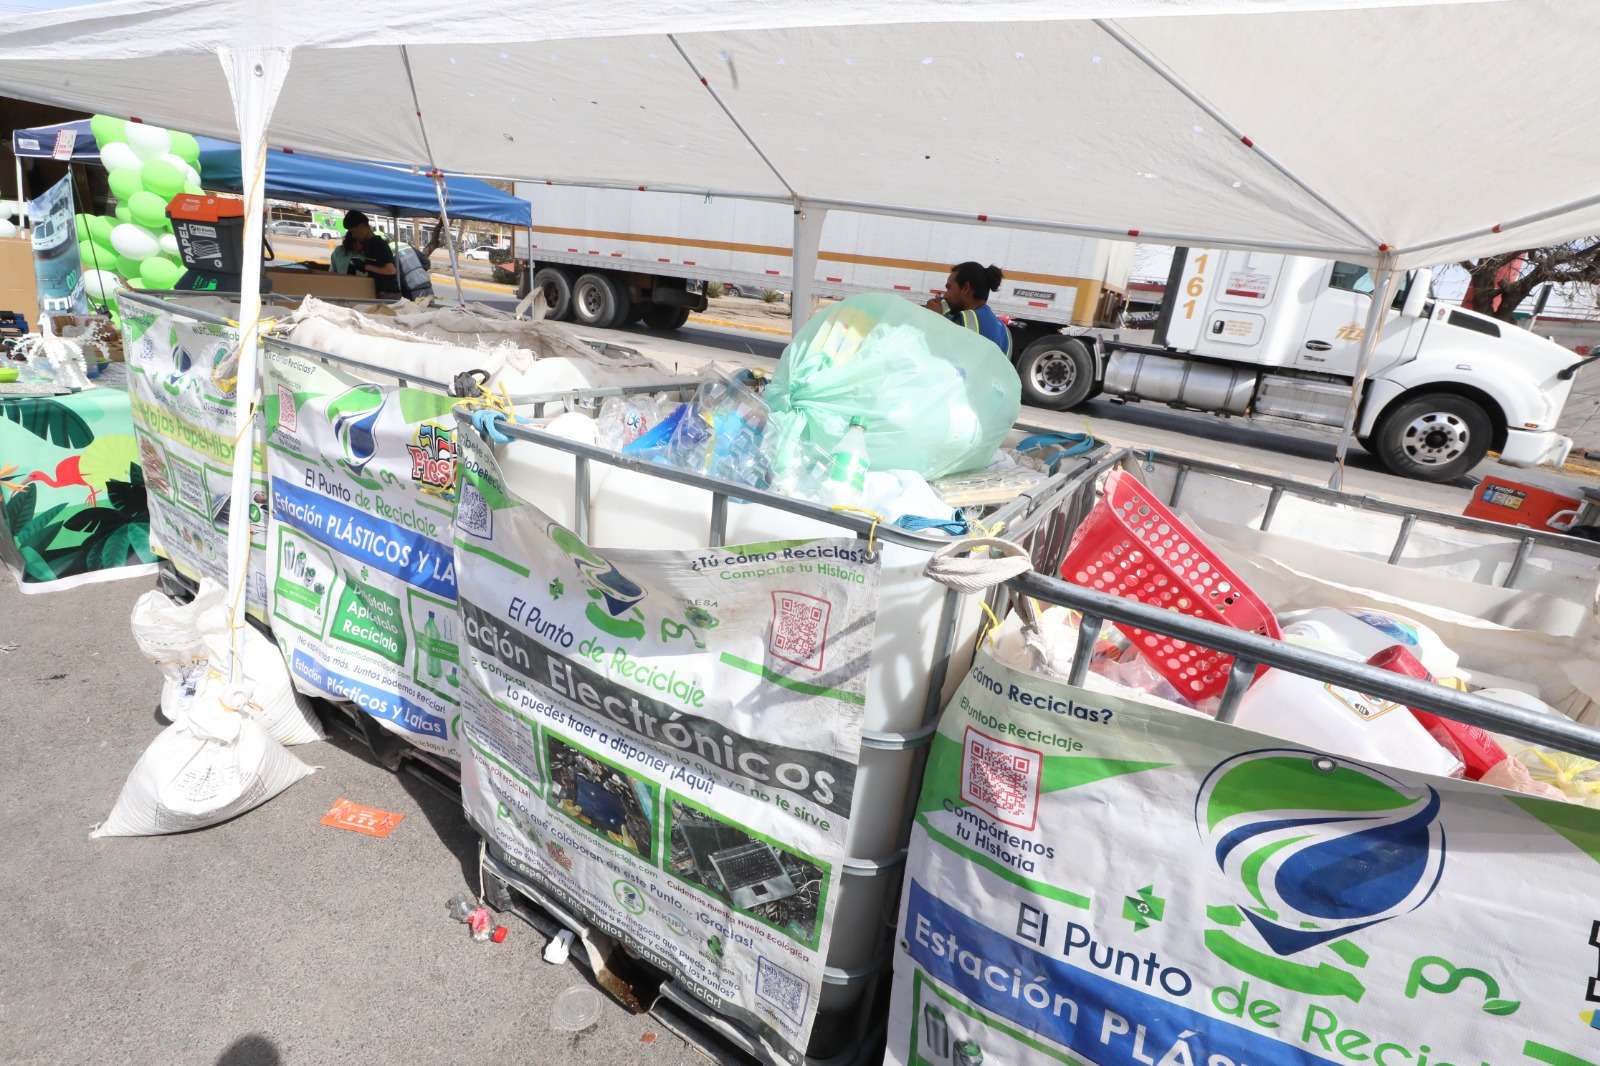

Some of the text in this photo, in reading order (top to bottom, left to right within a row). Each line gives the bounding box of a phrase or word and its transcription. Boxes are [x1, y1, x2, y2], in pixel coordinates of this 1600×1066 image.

[178, 222, 197, 264] PAPEL
[275, 492, 323, 529] Estación
[326, 515, 412, 568] PLÁSTICOS
[418, 551, 430, 574] Y
[305, 468, 438, 538] El Punto de Reciclaje
[691, 545, 865, 572] ¿Tú cómo Reciclas?
[719, 561, 866, 585] Comparte tu Historia
[352, 664, 381, 682] Juntos
[381, 676, 416, 699] podemos
[508, 596, 706, 709] El Punto de Reciclaje
[295, 658, 442, 734] Estación Plásticos y Latas
[959, 695, 1084, 753] ElPuntoDeReciclaje
[1008, 684, 1114, 726] Reciclas?
[506, 685, 715, 796] Lo puedes traer a disponer ¡Aquí!
[546, 653, 836, 806] Electrónicos
[774, 794, 790, 812] te
[794, 806, 831, 832] sirve
[942, 798, 1055, 860] Compártenos
[956, 821, 1036, 874] tu Historia
[551, 826, 604, 865] colaboran
[695, 910, 754, 950] ¡Gracias!
[591, 914, 622, 939] Juntos
[625, 934, 673, 973] podemos
[674, 968, 722, 1010] Reciclar!
[663, 936, 679, 952] que
[679, 945, 706, 972] pueda
[914, 912, 1080, 1025] Estación
[1015, 901, 1049, 948] El
[1063, 921, 1193, 997] Punto
[1210, 980, 1282, 1029] de
